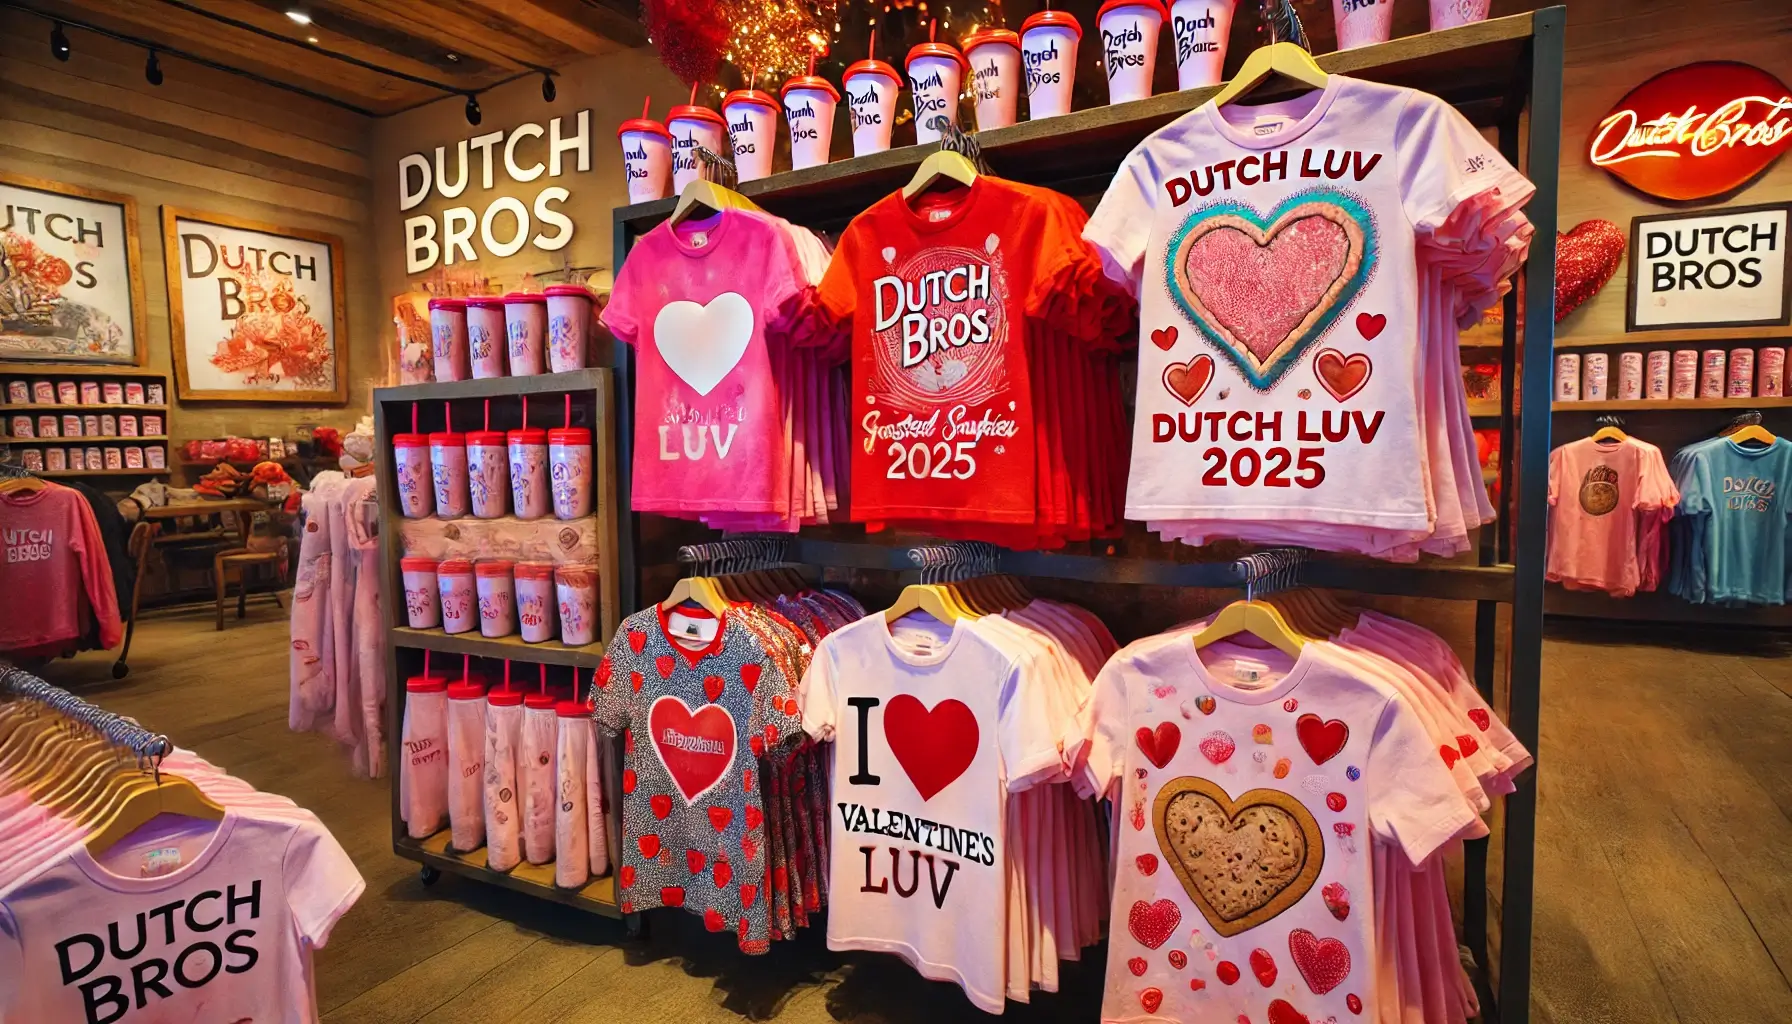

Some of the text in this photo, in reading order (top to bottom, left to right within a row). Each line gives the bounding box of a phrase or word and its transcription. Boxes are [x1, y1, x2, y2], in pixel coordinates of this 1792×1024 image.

[399, 109, 590, 211] DUTCH
[1165, 148, 1383, 207] DUTCH LUV
[181, 233, 316, 281] DUTCH
[404, 186, 575, 274] BROS
[1646, 222, 1778, 259] DUTCH
[873, 264, 991, 332] DUTCH
[1652, 257, 1763, 293] BROS
[902, 308, 991, 368] BROS
[658, 423, 738, 461] LUV
[1152, 410, 1386, 444] DUTCH LUV
[886, 441, 977, 480] 2025
[1201, 446, 1326, 489] 2025
[847, 697, 881, 786] I
[837, 802, 995, 867] VALENTINE'S
[858, 846, 960, 910] LUV
[54, 879, 262, 986] DUTCH
[77, 929, 259, 1024] BROS
